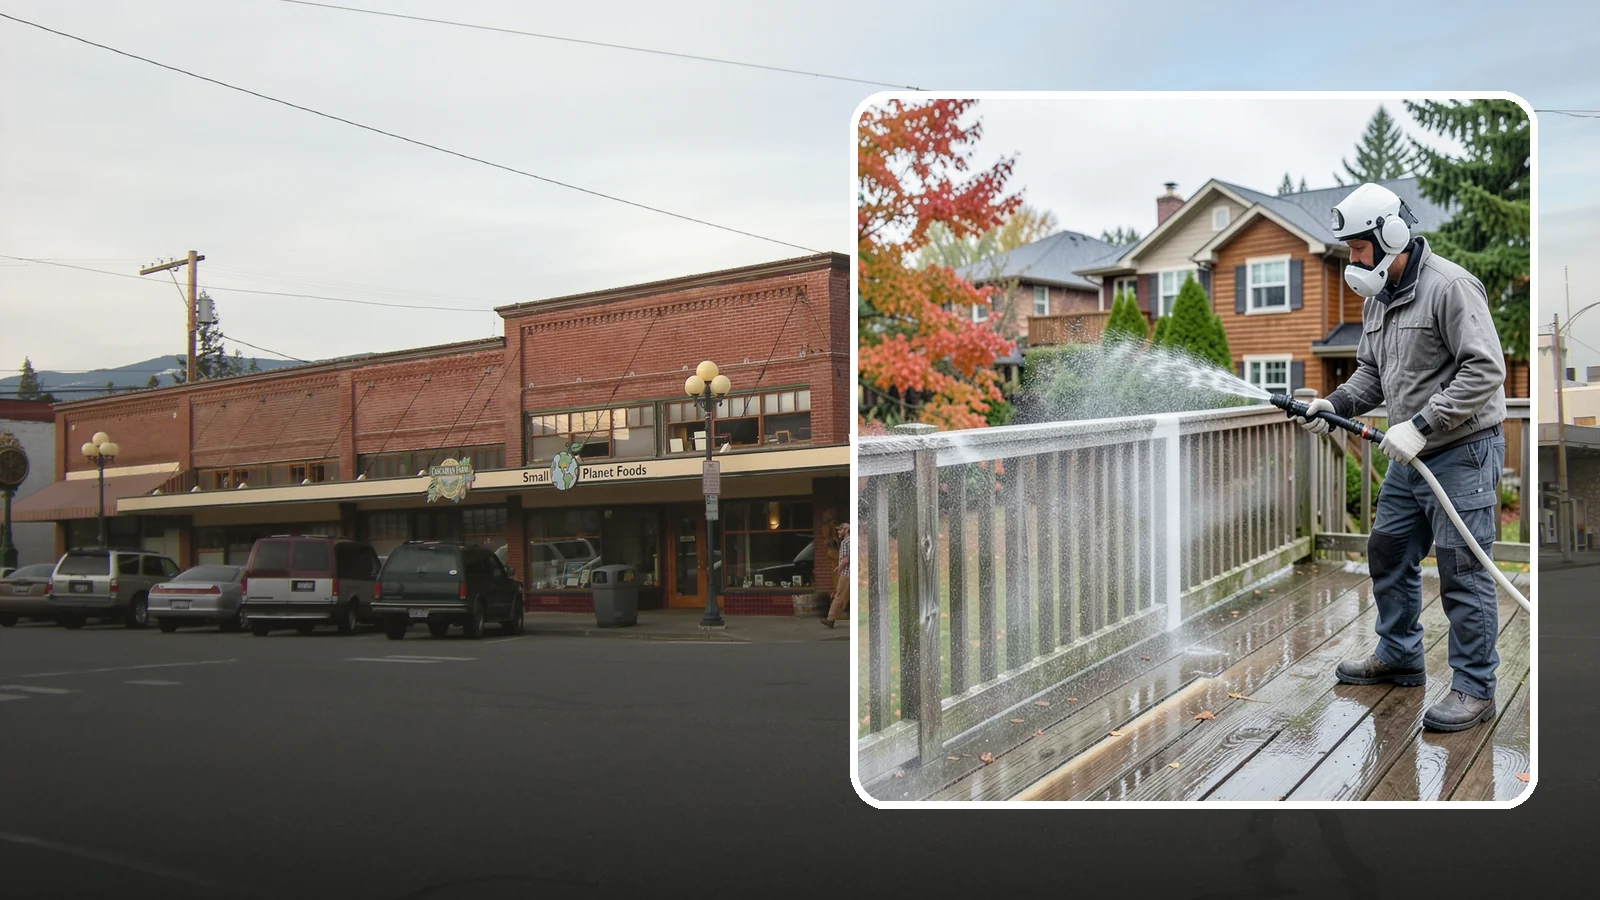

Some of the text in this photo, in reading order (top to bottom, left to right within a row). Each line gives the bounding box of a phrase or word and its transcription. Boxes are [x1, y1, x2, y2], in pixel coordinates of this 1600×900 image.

[523, 464, 647, 482] Small Planet Foods
